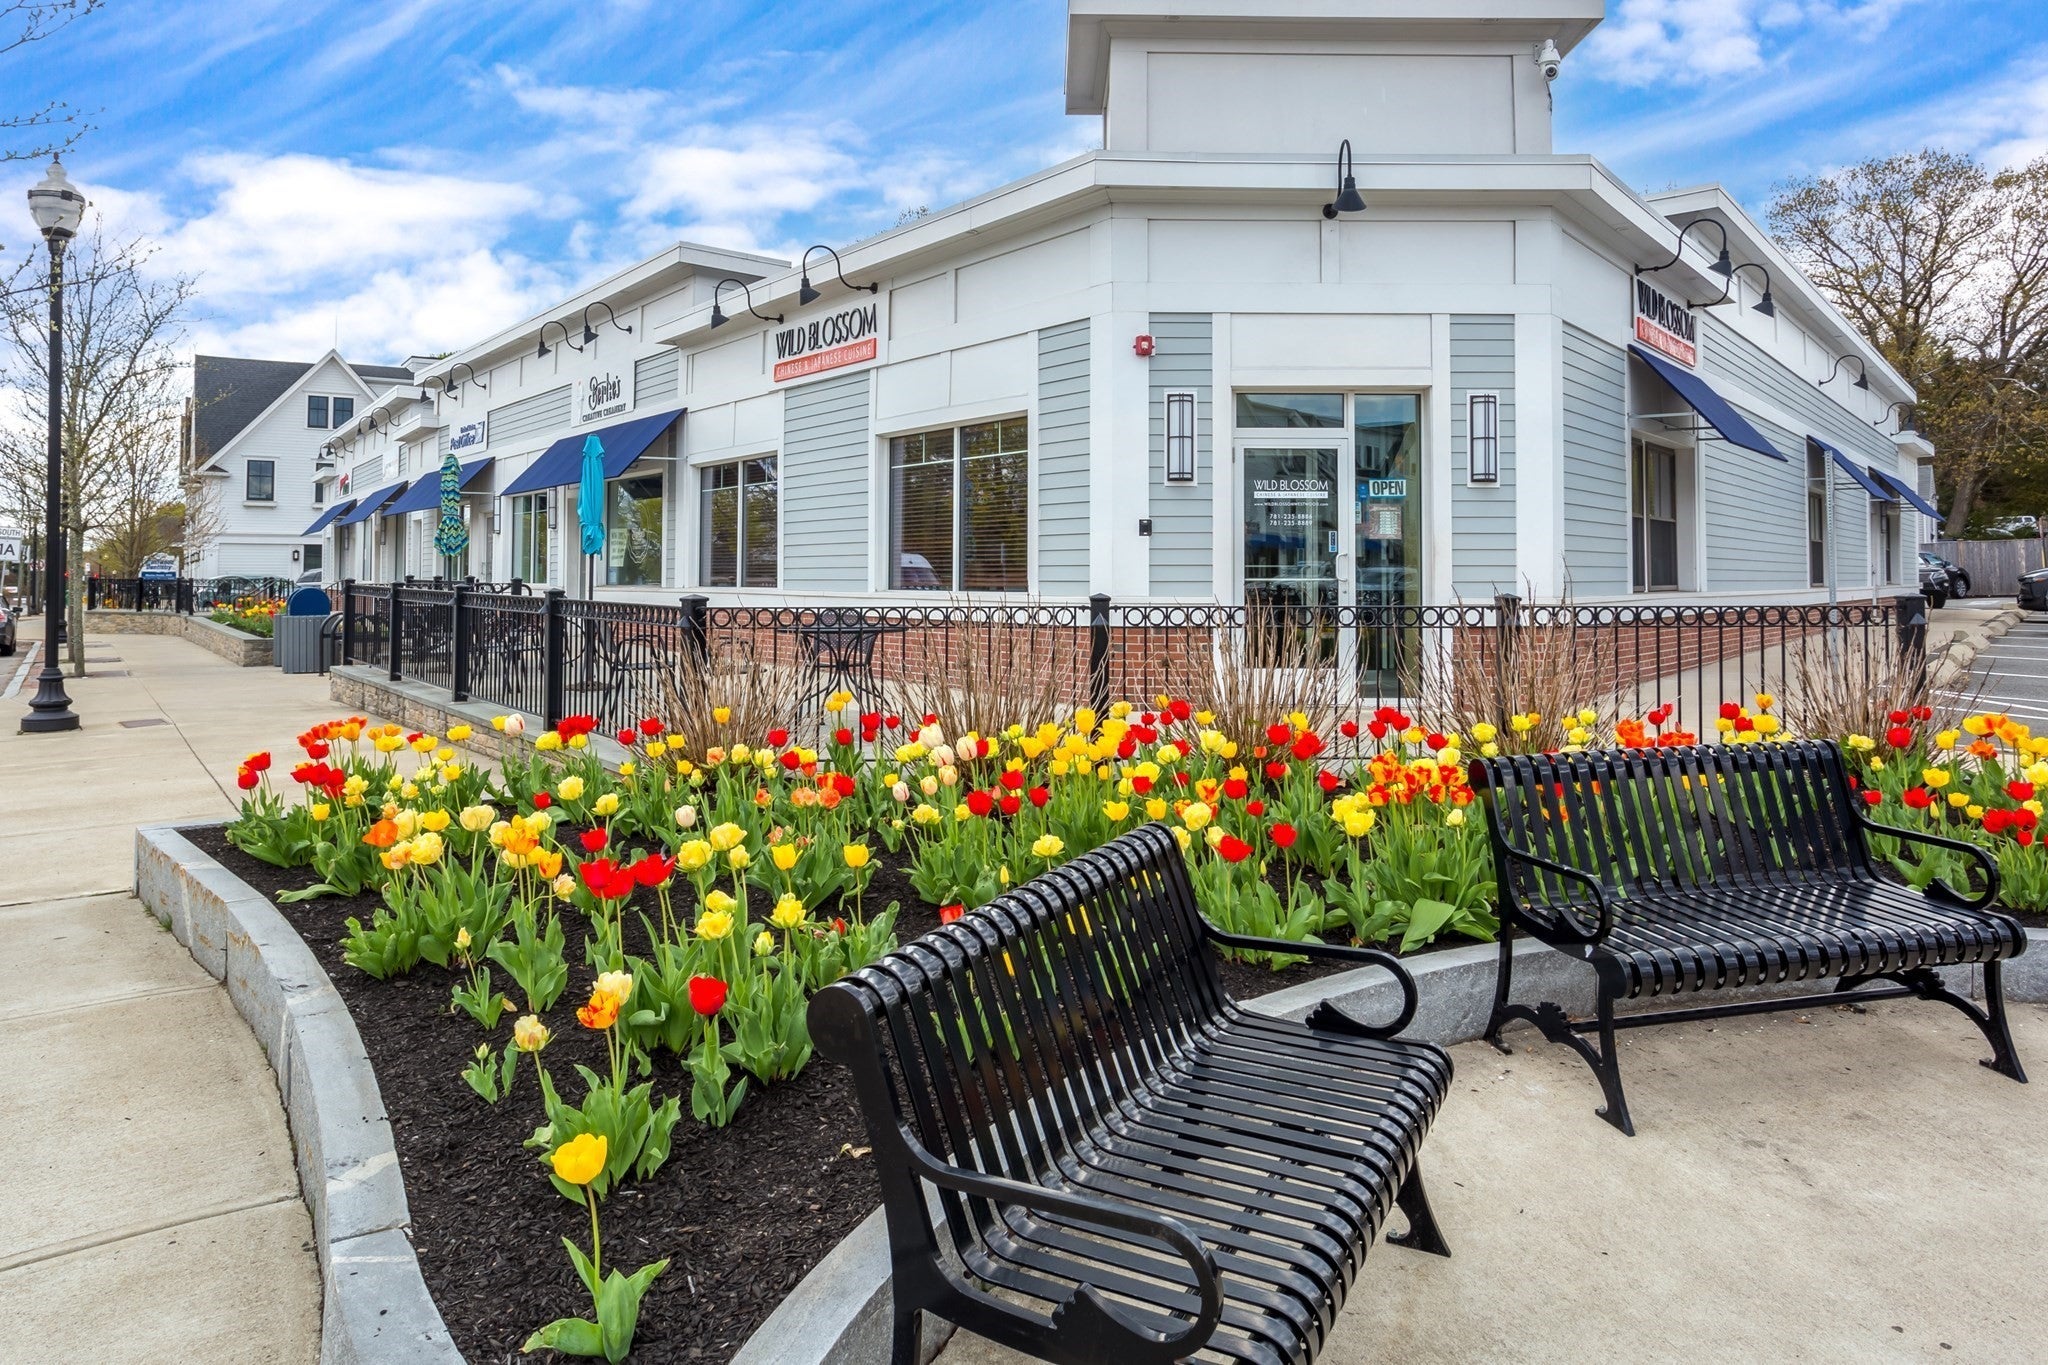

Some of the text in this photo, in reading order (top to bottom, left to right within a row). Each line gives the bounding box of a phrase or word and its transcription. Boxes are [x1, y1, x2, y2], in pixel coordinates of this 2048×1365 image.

[1637, 279, 1657, 320] WILD
[1658, 293, 1695, 343] BLOSSOM
[776, 303, 877, 359] WILD BLOSSOM
[777, 362, 802, 378] CHINESE
[811, 352, 841, 370] JAPANESE
[843, 343, 872, 361] CUISINE
[1254, 479, 1328, 491] WILD BLOSSOM
[1372, 480, 1404, 496] OPEN
